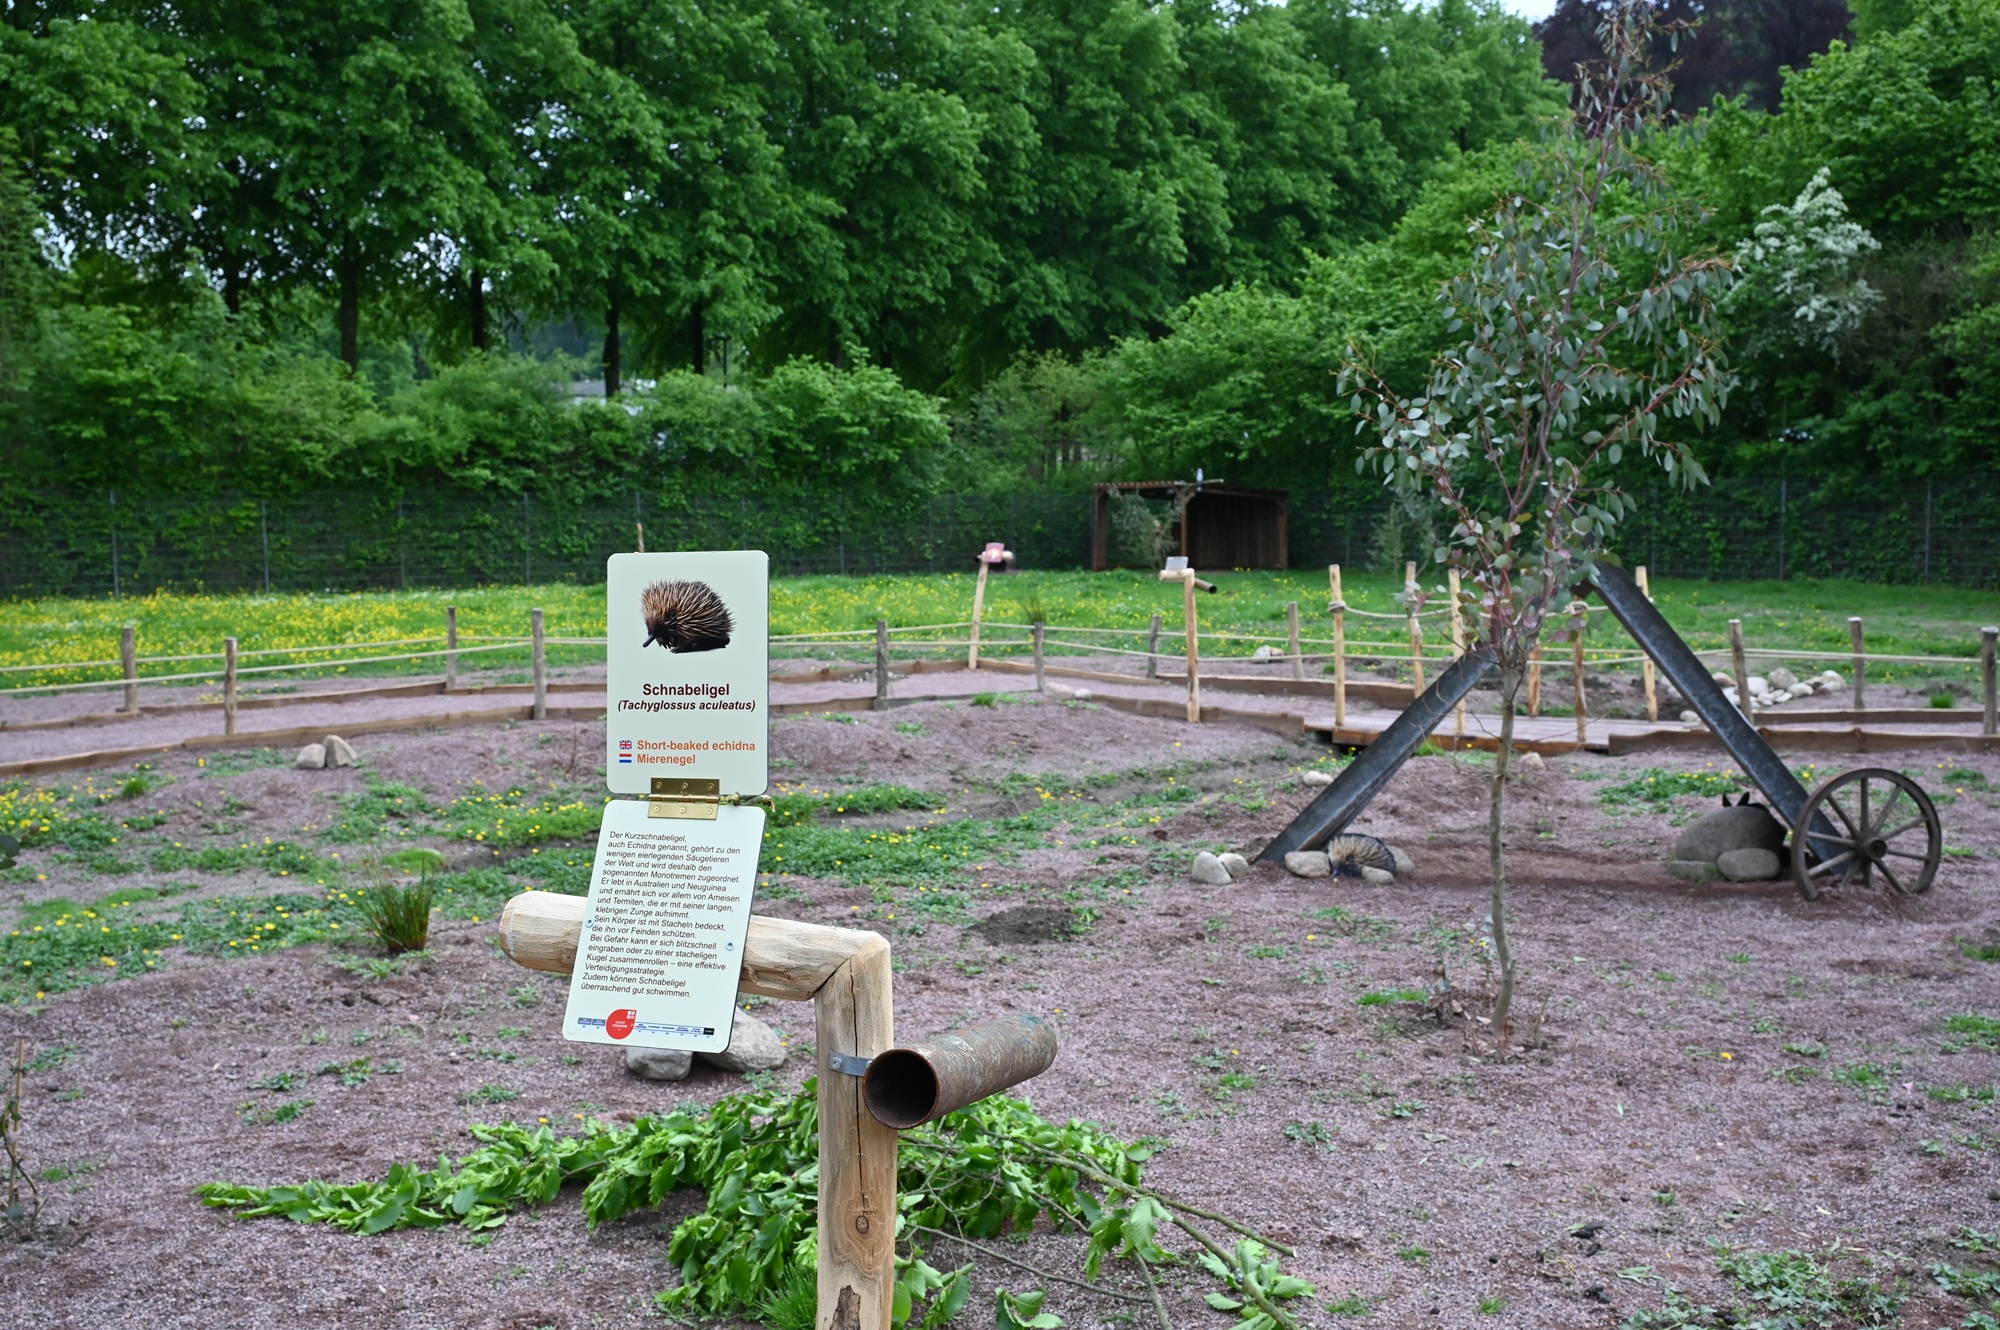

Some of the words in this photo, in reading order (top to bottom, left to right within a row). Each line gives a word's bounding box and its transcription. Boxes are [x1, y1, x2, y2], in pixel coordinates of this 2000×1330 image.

[643, 683, 729, 699] Schnabeligel
[618, 700, 696, 712] (Tachyglossus
[699, 700, 755, 712] aculeatus)
[637, 740, 709, 750] Short-beaked
[712, 741, 755, 751] echidna
[637, 754, 695, 766] Mierenegel
[625, 832, 686, 843] Kurzschnabeligel,
[627, 841, 656, 849] Echidna
[607, 851, 636, 859] wenigen
[638, 852, 684, 861] eierlegenden
[686, 854, 729, 863] Säugetieren
[668, 863, 696, 871] deshalb
[651, 871, 696, 880] Monotremen
[697, 875, 740, 883] zugeordnet.
[634, 880, 669, 888] Australien
[687, 883, 726, 892] Neuguinea
[708, 894, 740, 902] Ameisen
[614, 897, 645, 906] Termiten,
[707, 903, 733, 912] langen,
[596, 906, 628, 915] klebrigen
[629, 908, 653, 917] Zunge
[655, 910, 690, 918] aufnimmt.
[612, 916, 636, 925] Körper
[661, 919, 693, 928] Stacheln
[695, 922, 725, 931] bedeckt,
[631, 927, 660, 936] Feinden
[662, 930, 696, 938] schützen.
[604, 935, 629, 943] Gefahr
[676, 940, 716, 949] blitzschnell
[588, 945, 624, 953] eingraben
[675, 951, 717, 960] stacheligen
[586, 953, 608, 963] Kugel
[609, 956, 668, 966] zusammenrollen
[695, 961, 725, 970] effektive
[585, 963, 666, 977] Verteidigungsstrategie.
[582, 972, 608, 981] Zudem
[610, 975, 637, 983] können
[639, 976, 686, 988] Schnabeligel
[581, 983, 631, 993] überraschend
[632, 987, 644, 995] gut
[646, 988, 692, 997] schwimmen.
